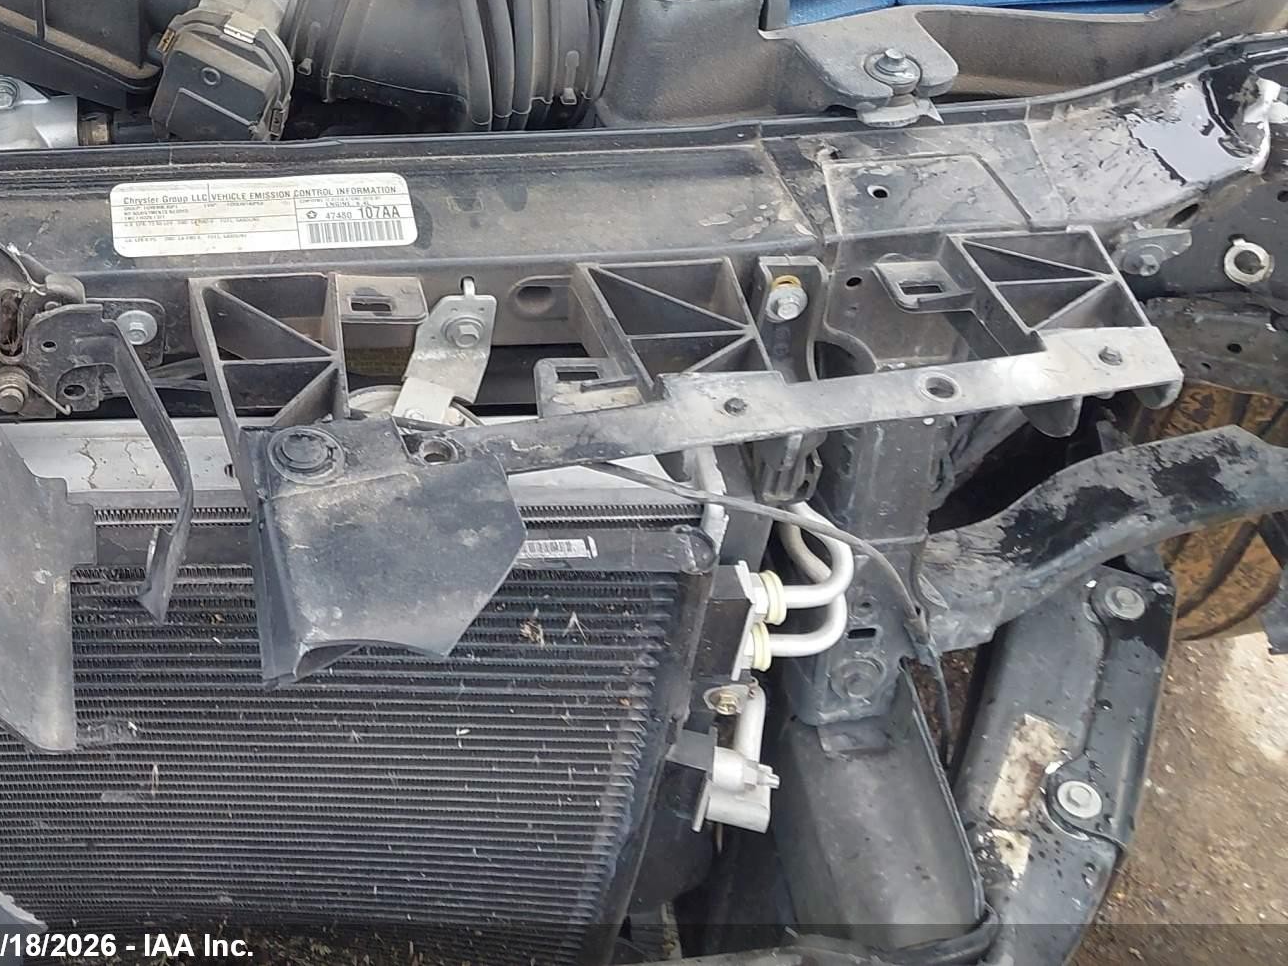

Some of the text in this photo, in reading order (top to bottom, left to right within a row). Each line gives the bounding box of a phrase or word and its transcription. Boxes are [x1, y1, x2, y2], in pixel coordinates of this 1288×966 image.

[123, 186, 397, 205] Chrysler Group LLC VEHICLE EMISSION CONTROL INFORMATION
[359, 205, 401, 219] 107AA
